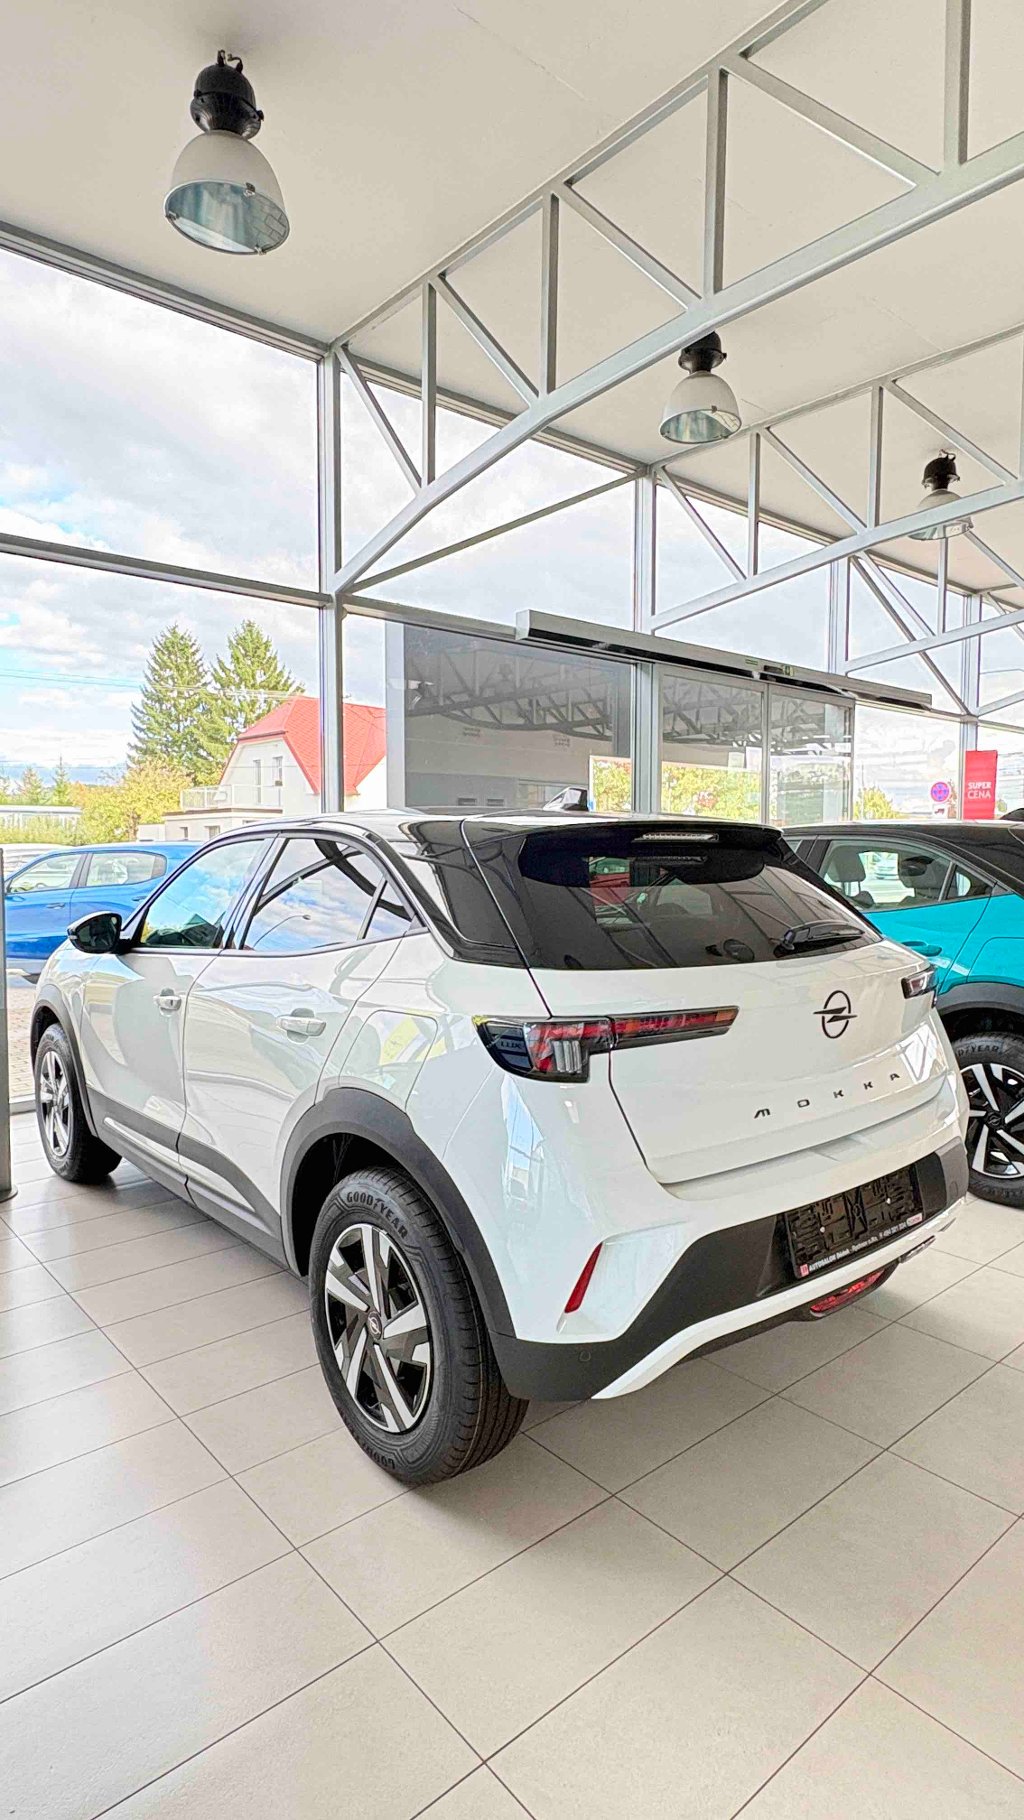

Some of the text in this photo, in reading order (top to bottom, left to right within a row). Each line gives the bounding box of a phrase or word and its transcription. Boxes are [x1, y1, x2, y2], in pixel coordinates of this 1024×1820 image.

[967, 781, 992, 790] SUPER
[967, 790, 992, 799] CENA
[754, 1073, 900, 1119] MOKKA
